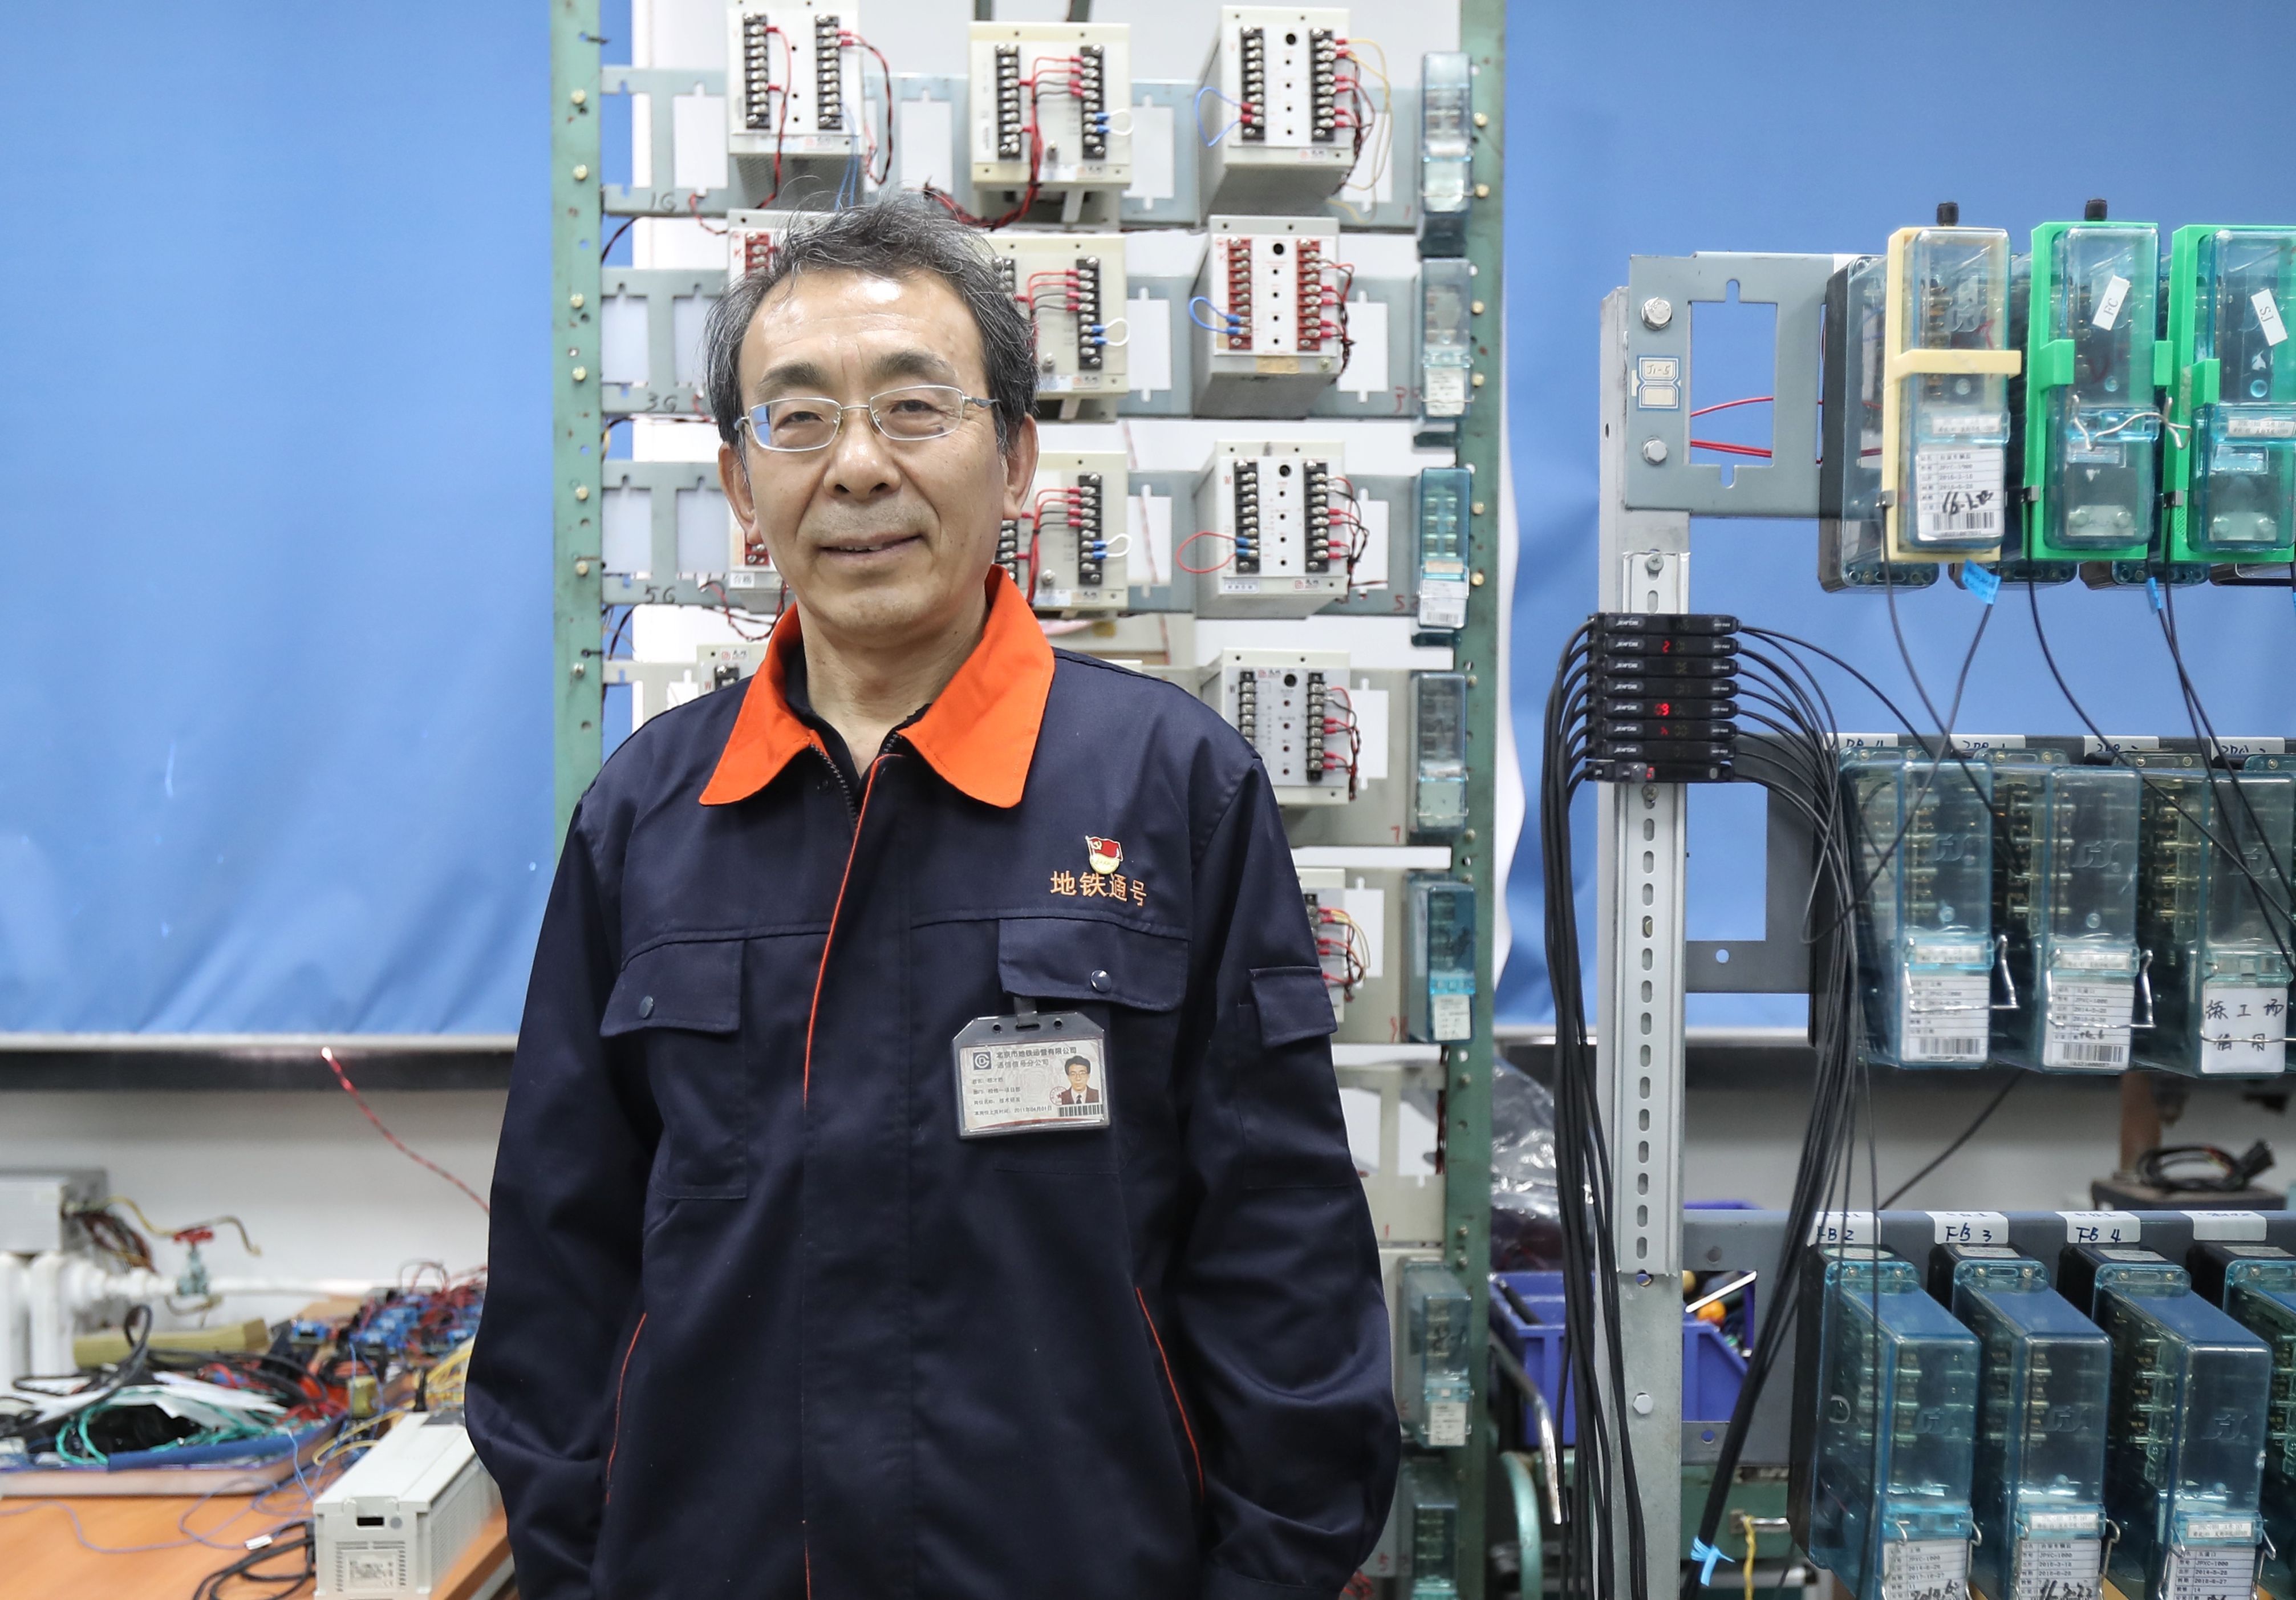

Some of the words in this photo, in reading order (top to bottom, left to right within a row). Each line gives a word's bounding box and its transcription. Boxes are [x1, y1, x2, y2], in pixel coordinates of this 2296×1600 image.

[2104, 298, 2119, 315] FC
[1050, 871, 1147, 906] 地铁通号
[996, 1047, 1077, 1059] 北京市地铁运营有限公司
[997, 1059, 1049, 1068] 通信信号分公司
[1982, 1230, 1992, 1242] 3
[2111, 1229, 2121, 1242] 4
